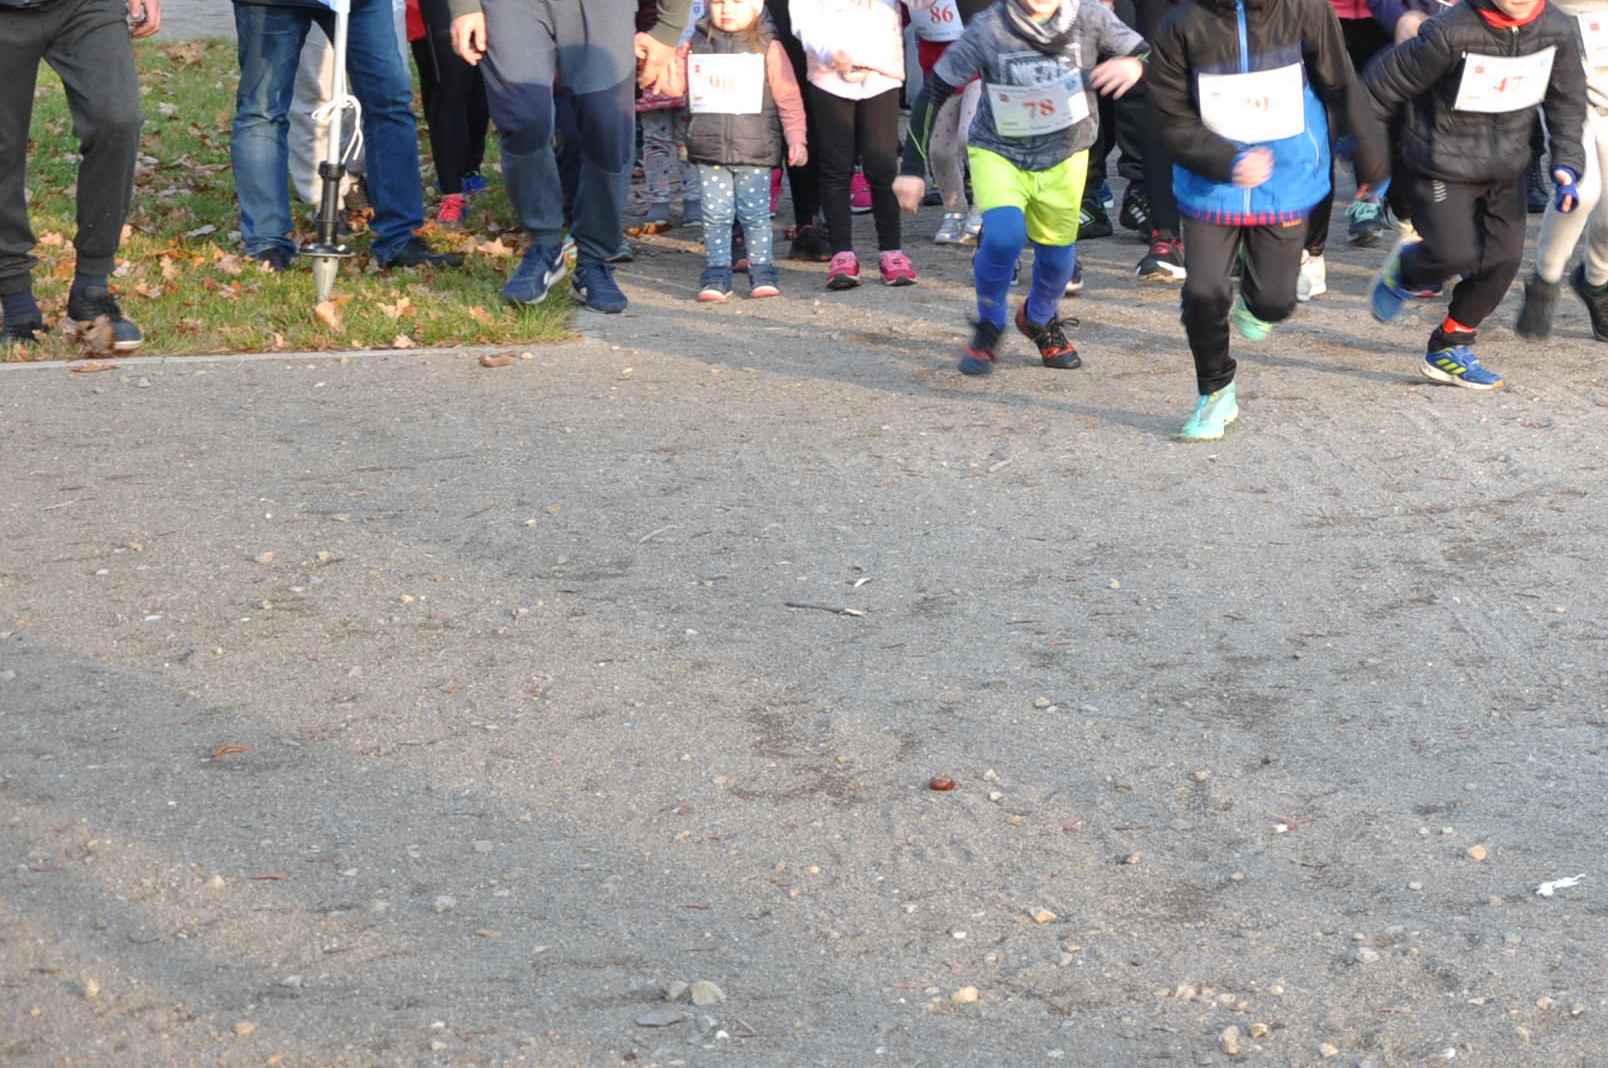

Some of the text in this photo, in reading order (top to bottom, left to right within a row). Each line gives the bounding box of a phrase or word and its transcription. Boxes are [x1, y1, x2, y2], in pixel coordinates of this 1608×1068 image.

[930, 6, 954, 25] 86
[1492, 75, 1524, 93] 47
[1022, 98, 1056, 119] 78
